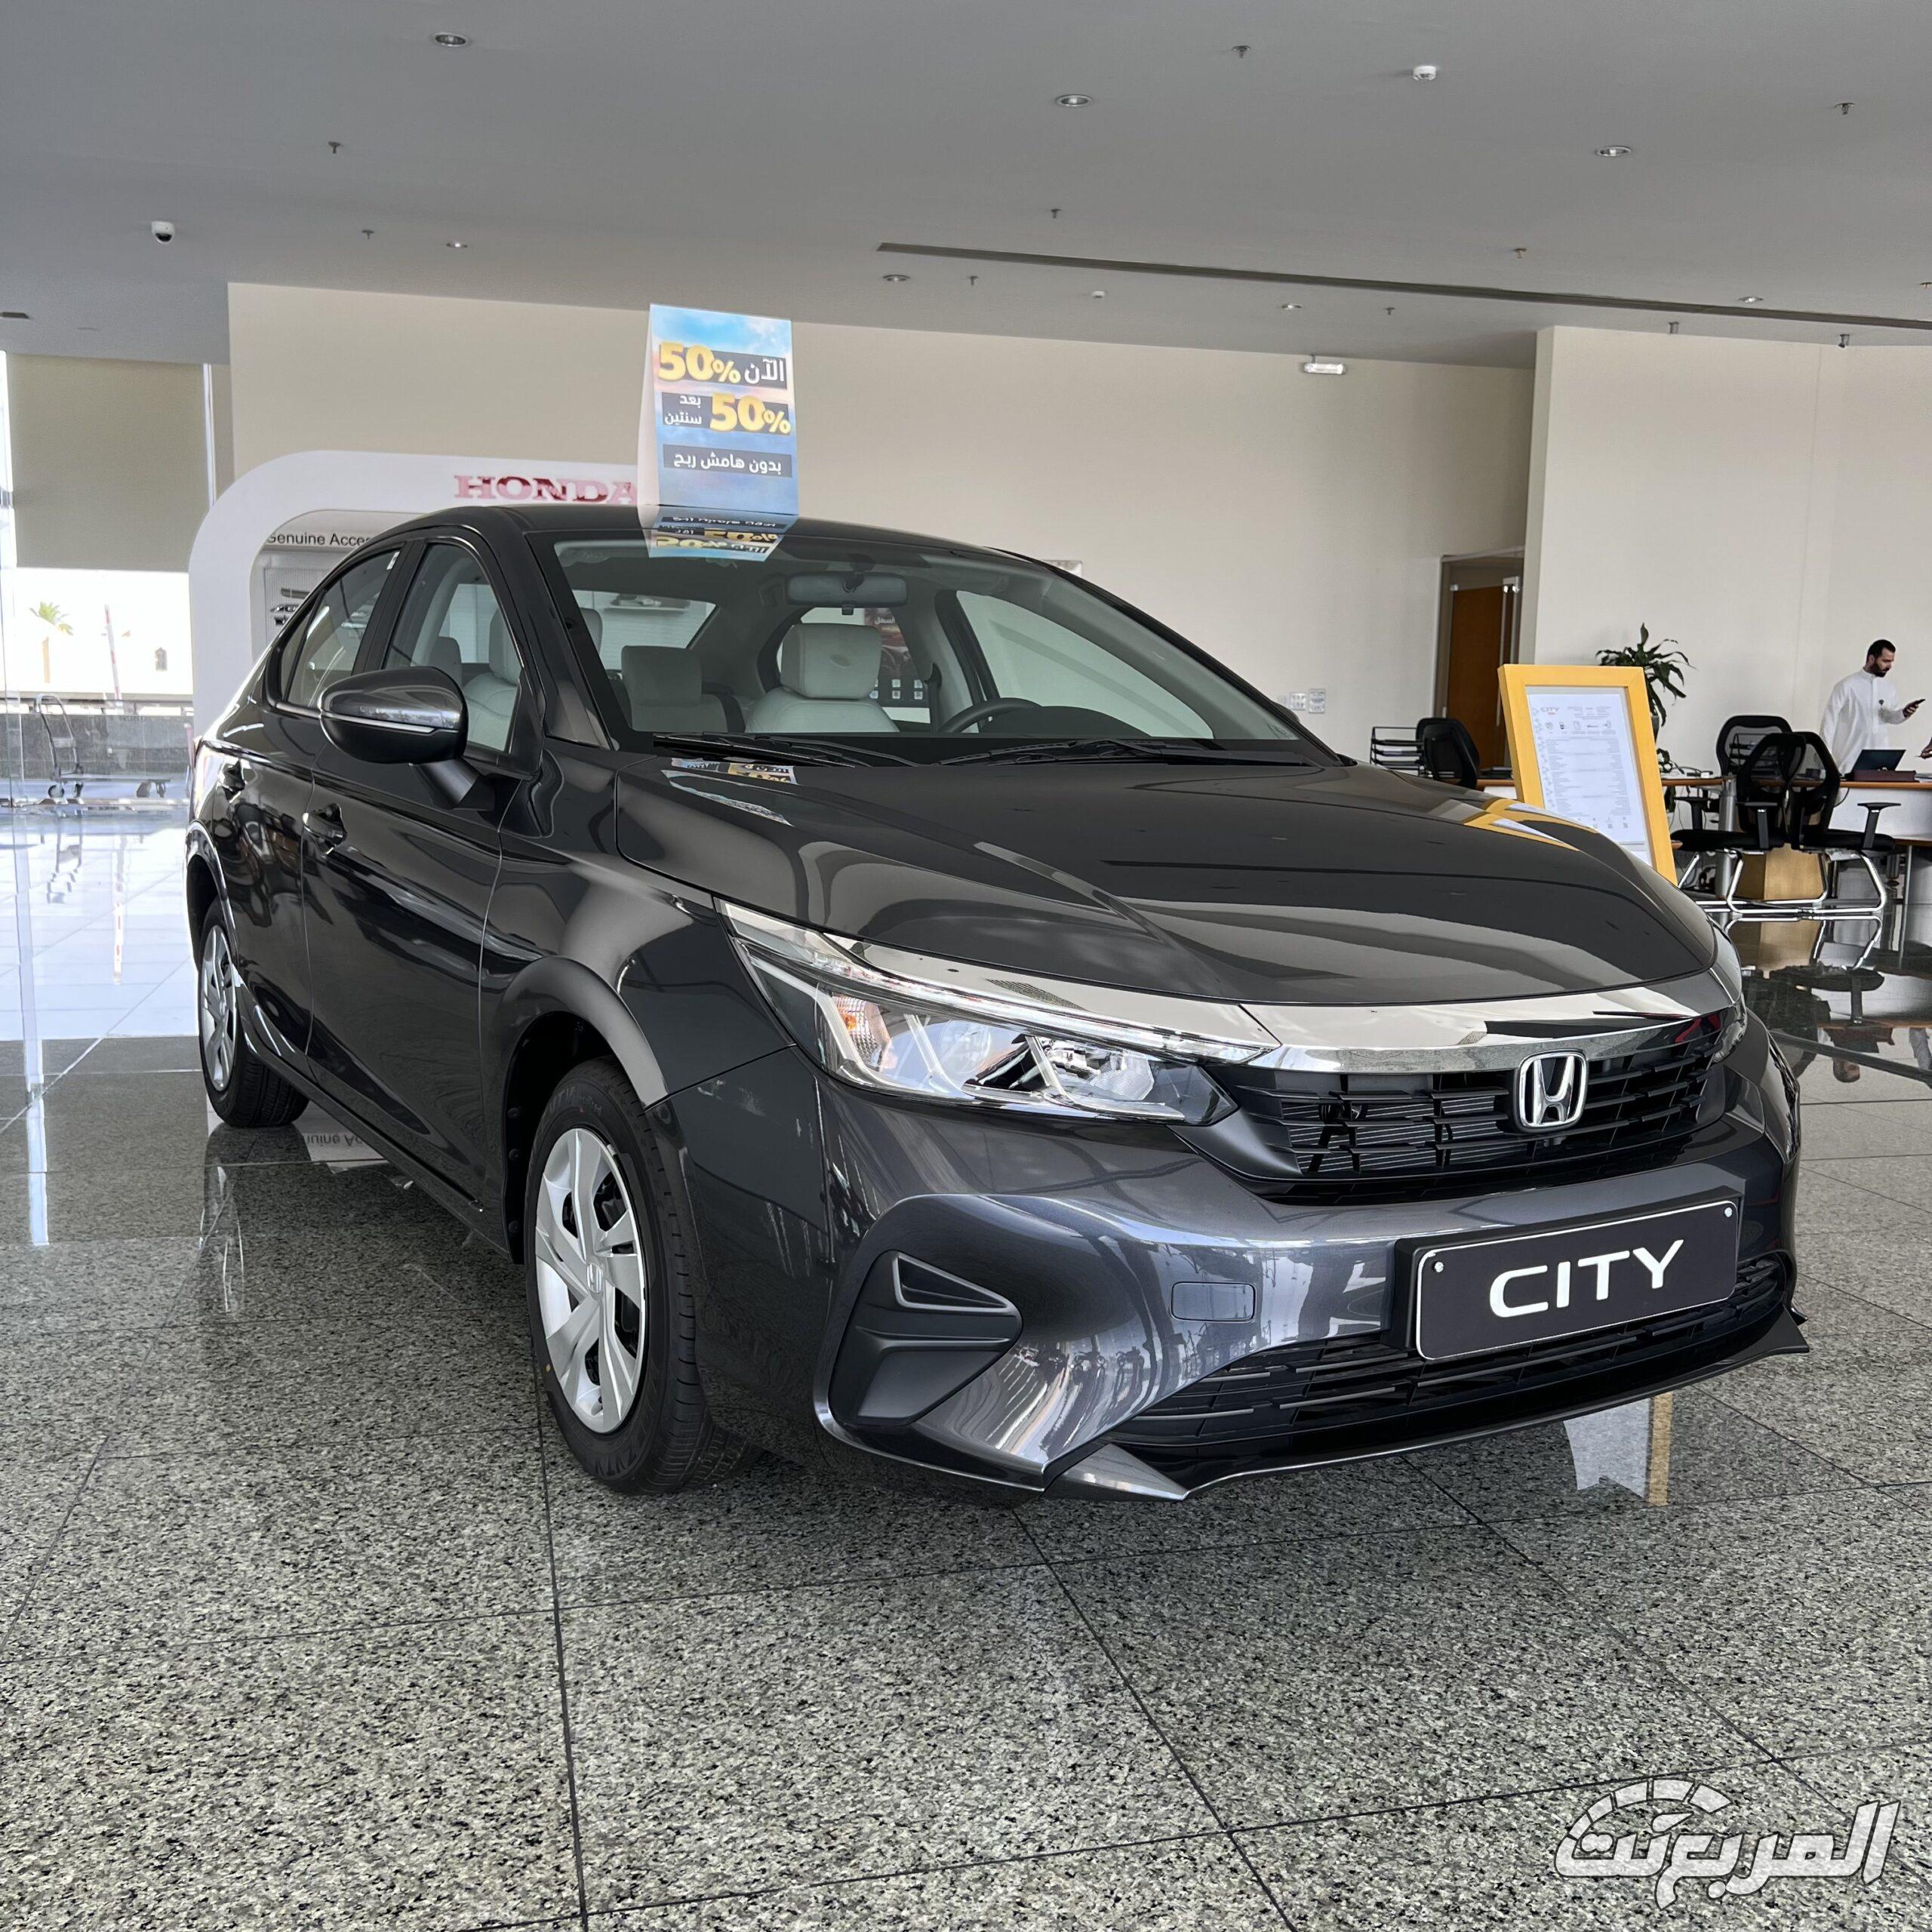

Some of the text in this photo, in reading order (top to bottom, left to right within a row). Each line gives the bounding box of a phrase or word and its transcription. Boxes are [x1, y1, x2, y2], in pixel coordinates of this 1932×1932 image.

[657, 340, 786, 385] الآن 50%
[679, 394, 701, 409] بعد
[709, 392, 791, 435] 50%
[664, 410, 702, 427] سنتين
[673, 451, 782, 474] بدون هامش ربح
[454, 475, 637, 505] HONDA
[330, 533, 370, 546] Acce
[1489, 1239, 1684, 1318] CITY
